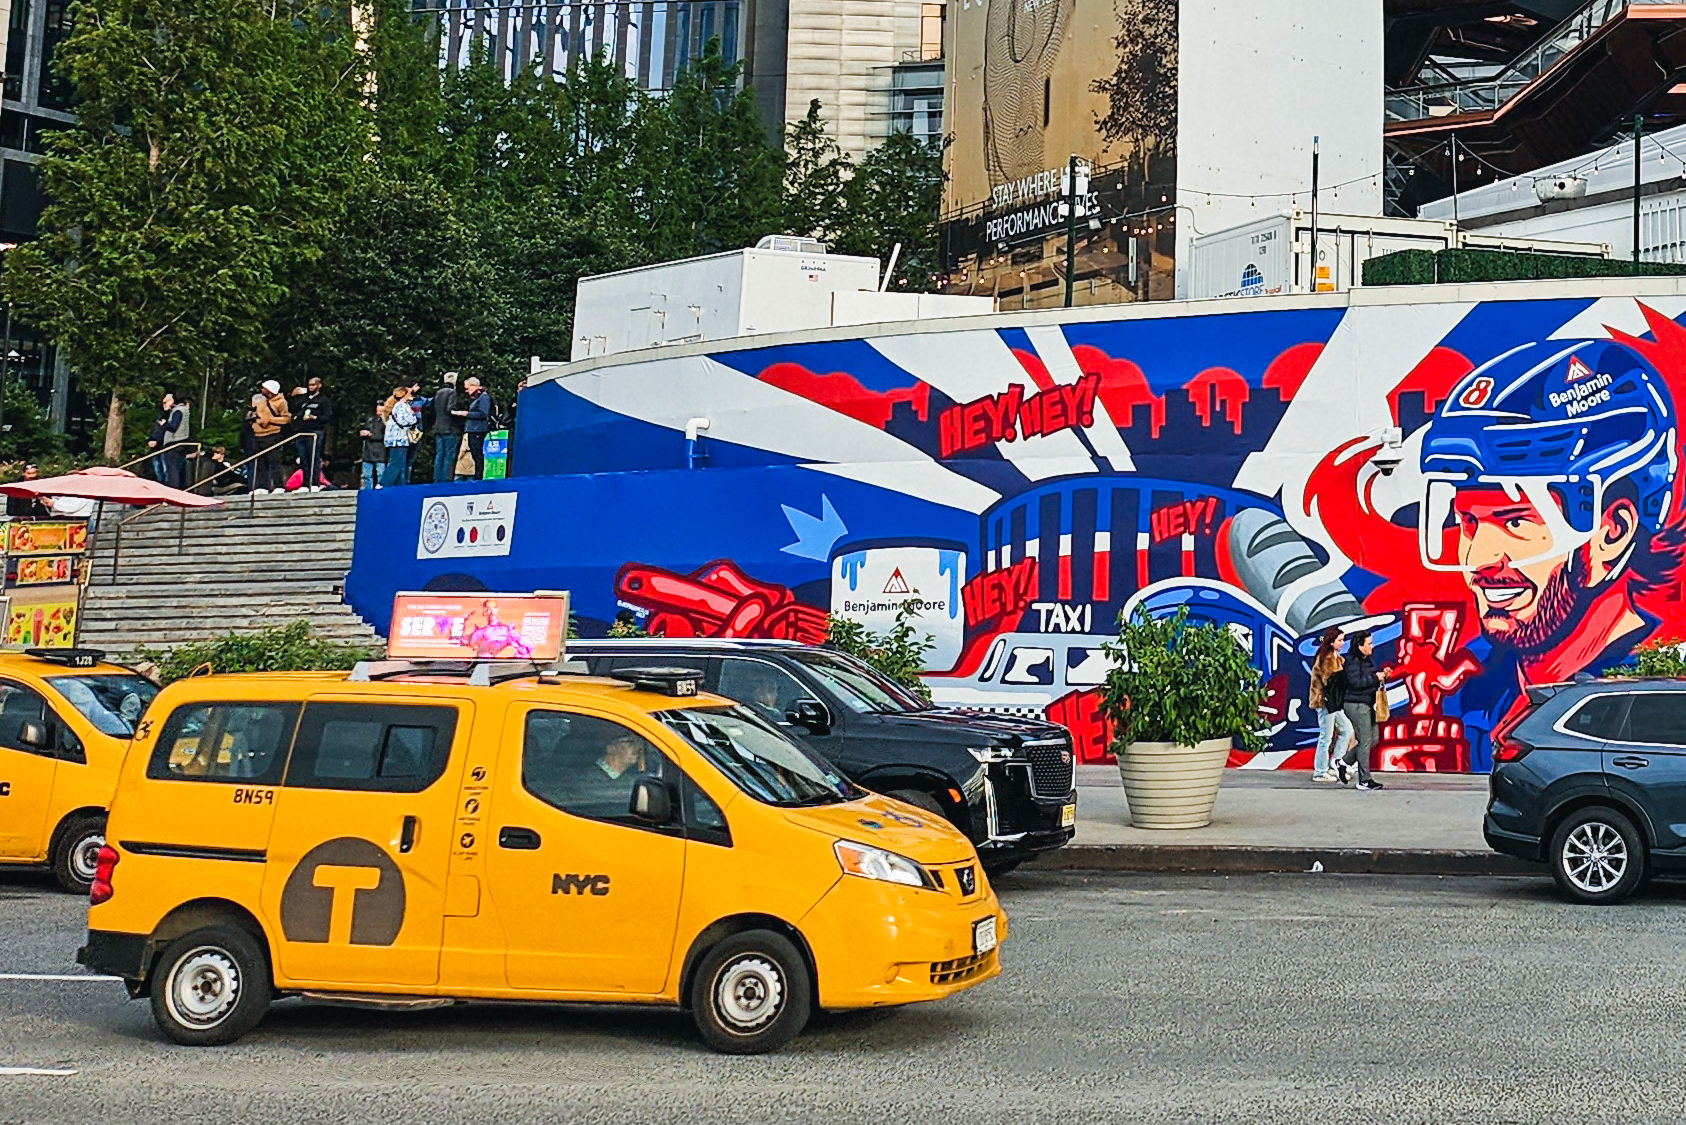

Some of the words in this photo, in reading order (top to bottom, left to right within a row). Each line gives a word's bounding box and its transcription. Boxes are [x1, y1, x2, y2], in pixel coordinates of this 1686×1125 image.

[992, 180, 1016, 211] STAY
[1016, 168, 1058, 199] WHERE
[985, 200, 1065, 243] PERFORMANCE
[1459, 377, 1495, 409] 8
[1548, 372, 1613, 408] Benjamin
[1565, 388, 1611, 418] Moore
[940, 384, 1023, 458] HEY!
[1019, 374, 1099, 440] HEY!
[1151, 496, 1218, 544] HEY!
[844, 599, 898, 615] Benjamin
[961, 557, 1037, 627] HEY!
[1031, 602, 1092, 633] TAXI
[233, 788, 275, 806] 8N59
[551, 872, 611, 896] NYC
[312, 863, 382, 945] T
